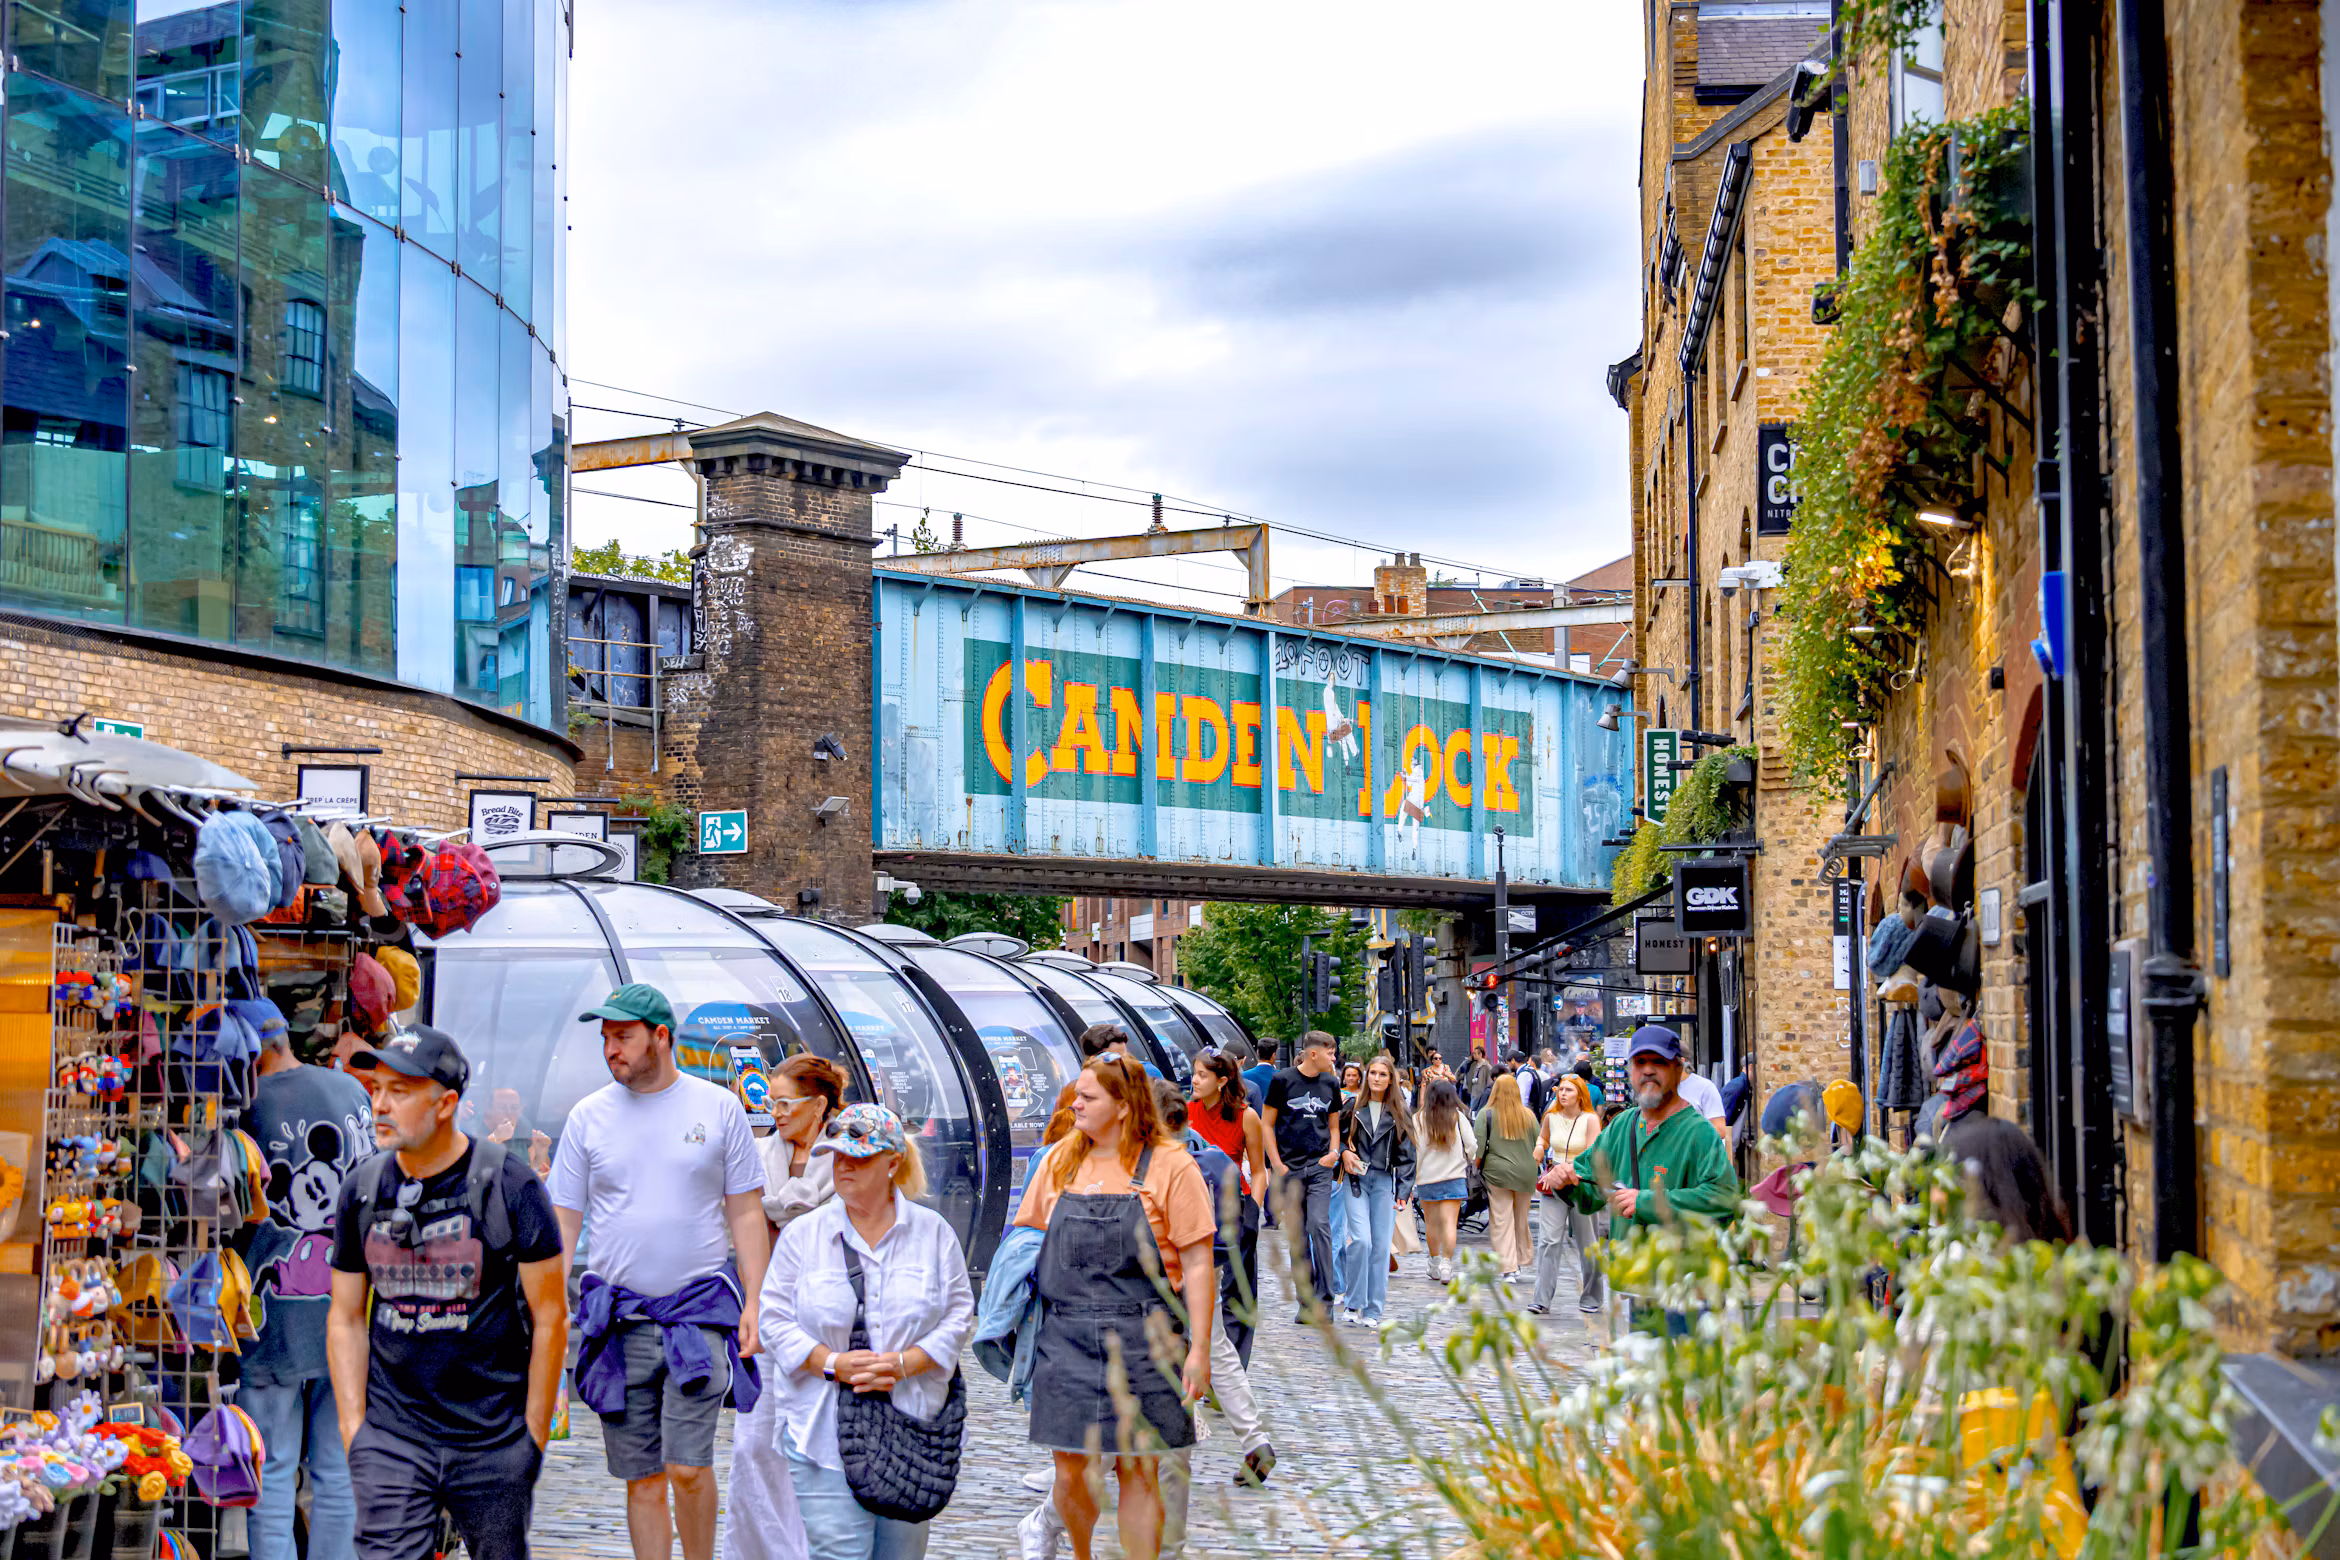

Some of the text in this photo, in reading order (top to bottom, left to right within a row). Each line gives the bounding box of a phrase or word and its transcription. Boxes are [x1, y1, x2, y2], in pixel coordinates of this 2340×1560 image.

[982, 658, 1520, 818] CAMDEN LOCK
[481, 805, 524, 818] Bread Bite
[1686, 887, 1739, 905] GDK
[1645, 940, 1685, 949] HONEST
[778, 989, 793, 1002] 18
[901, 1001, 913, 1012] 17
[698, 1016, 770, 1025] CAMDEN MARKET
